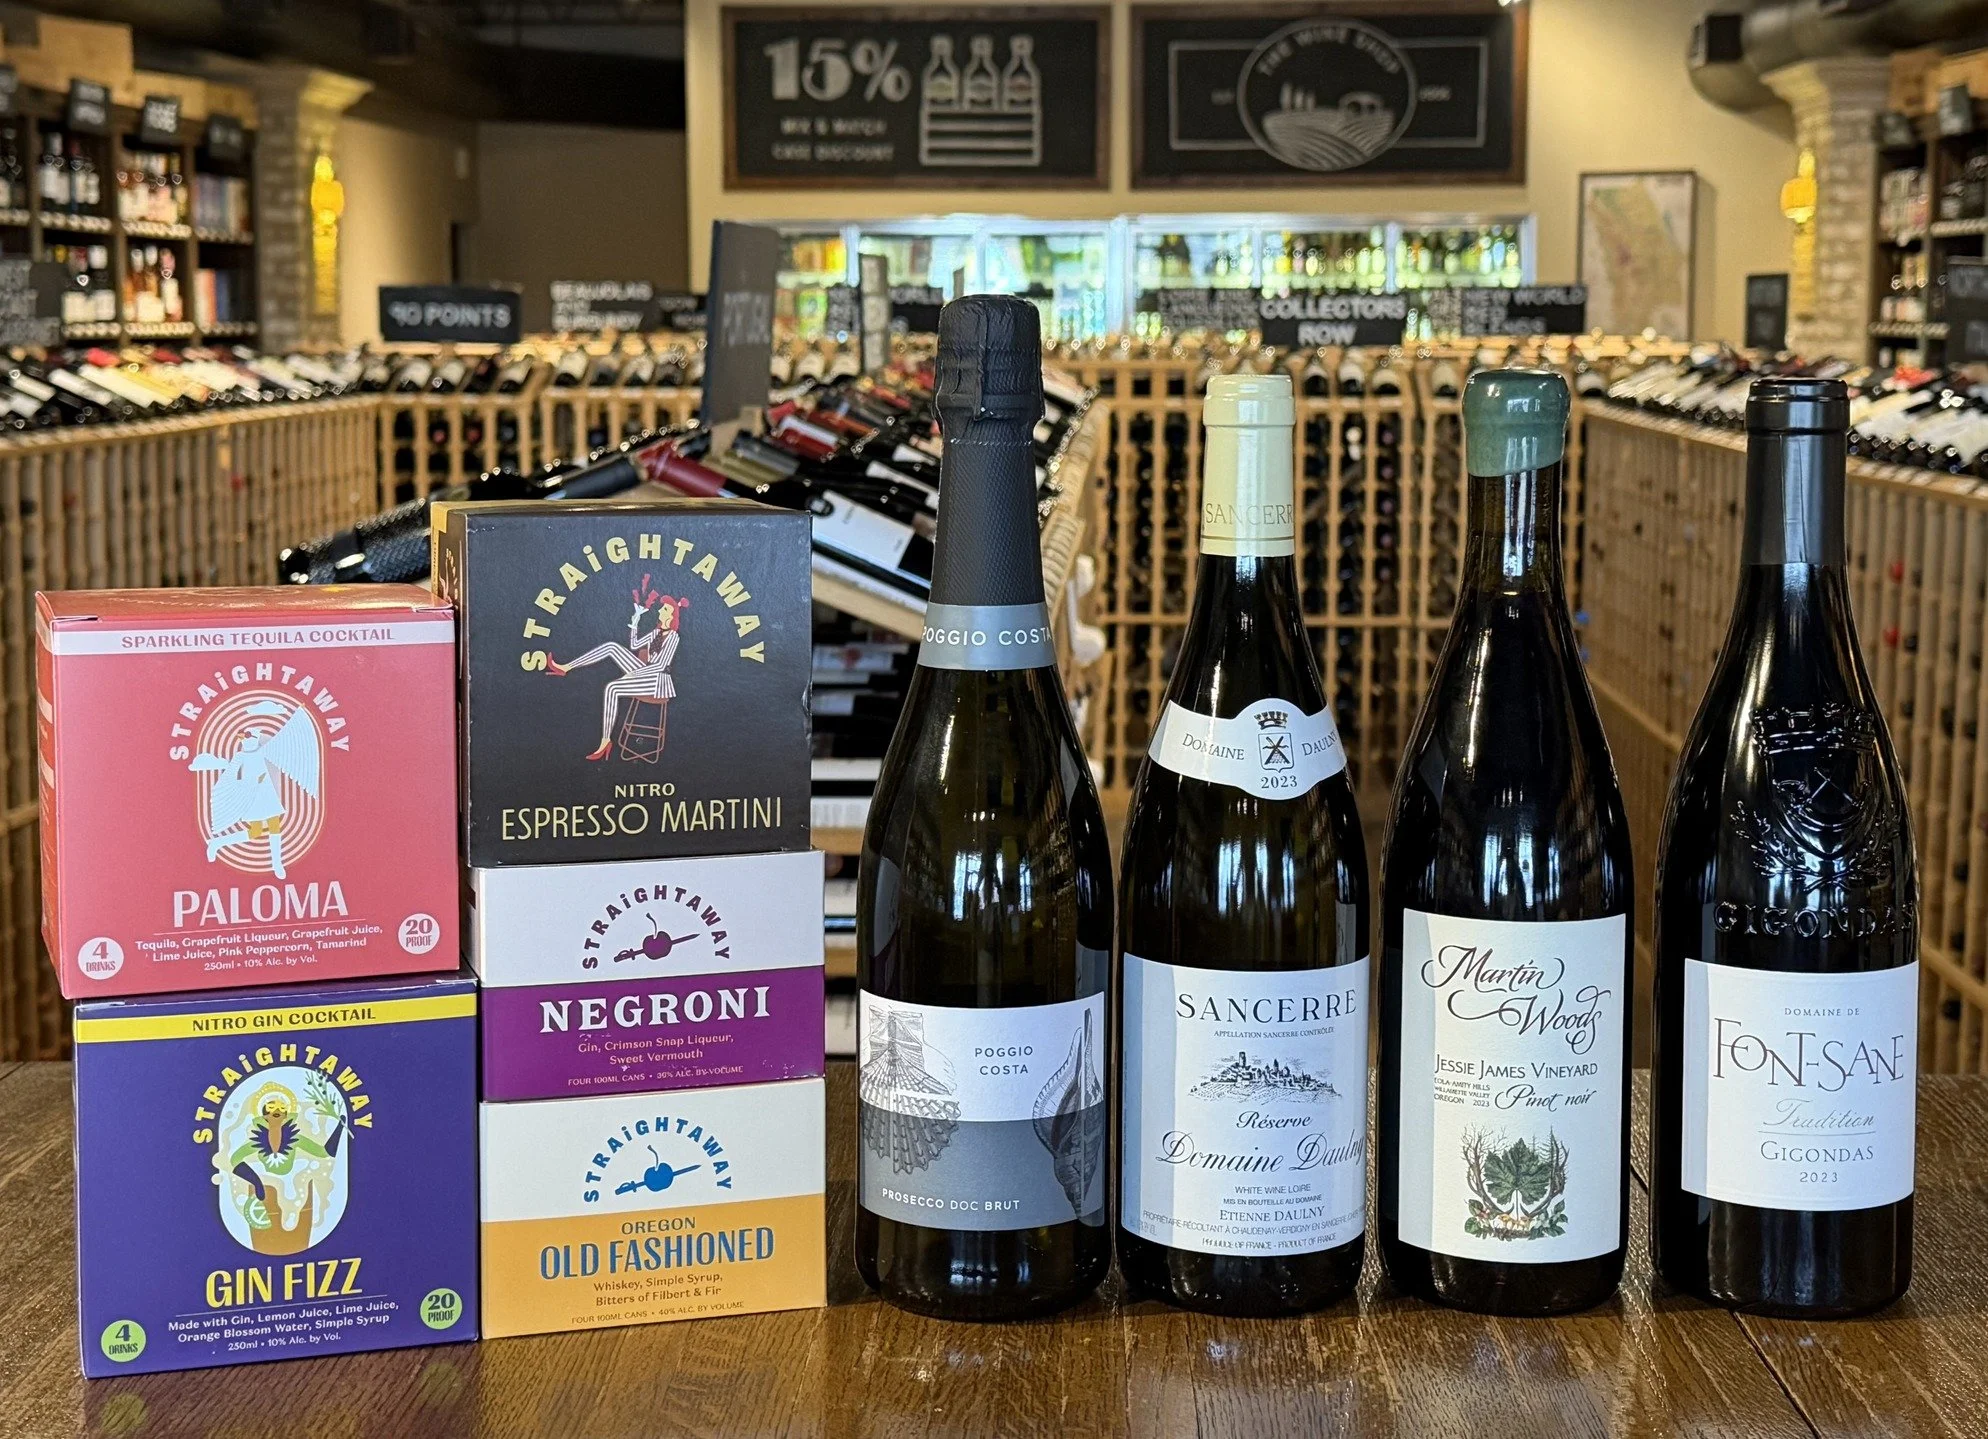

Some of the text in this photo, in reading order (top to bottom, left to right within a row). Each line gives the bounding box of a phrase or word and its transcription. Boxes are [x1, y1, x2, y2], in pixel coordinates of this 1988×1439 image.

[763, 38, 911, 101] 15%
[389, 301, 511, 328] 90 POINTS
[1260, 295, 1406, 320] COLLECTORS
[1298, 322, 1357, 346] ROW
[122, 626, 395, 649] SPARKLING TEQUILA COCKTAIL
[922, 626, 1052, 646] POGGIO COSTA
[1182, 733, 1245, 761] DOMAINE
[614, 782, 675, 799] NITRO
[1261, 776, 1298, 789] 2023
[502, 796, 782, 841] ESPRESSO MARTINI
[173, 880, 348, 928] PALOMA
[405, 918, 433, 935] 20
[135, 924, 383, 951] Tequila, Grapefruit Liqueur, Grapefruit Juice,
[405, 935, 433, 947] PROOF
[92, 941, 108, 958] 4
[153, 937, 367, 962] Lime Juice, Pink Peppercorn, Tamarind
[85, 959, 116, 973] DRINKS
[204, 954, 318, 971] 250ml 10% Alc. by Vol.
[1421, 945, 1565, 993] Martin
[539, 985, 770, 1034] NEGRONI
[1176, 989, 1357, 1023] SANCERRE
[1784, 1006, 1860, 1017] DOMAINE DE
[192, 1007, 376, 1032] NITRO GIN COCKTAIL
[1447, 985, 1611, 1055] Woods
[578, 1033, 734, 1053] Gin, Crimson Snap Liqueur,
[1214, 1029, 1298, 1039] APPELLATION SANCERRE
[609, 1049, 703, 1065] Sweet Vermouth
[975, 1045, 1034, 1058] POGGIO
[568, 1078, 592, 1086] FOUR
[594, 1075, 620, 1084] 100ML
[622, 1073, 645, 1082] CANS
[980, 1064, 1029, 1076] COSTA
[1433, 1093, 1490, 1107] OREGON 2023
[1494, 1083, 1597, 1112] Pinot noir
[1236, 1110, 1313, 1129] Réserve
[1763, 1097, 1875, 1130] Tradition
[1155, 1128, 1364, 1173] Domaine Daulny
[1760, 1140, 1874, 1163] GIGONDAS
[1800, 1171, 1838, 1183] 2023
[1235, 1184, 1311, 1194] WHITE WINE LOIRE
[882, 1188, 1020, 1211] PROSECCO DOC BRUT
[1248, 1198, 1284, 1206] BOUTEILLE
[1295, 1194, 1322, 1204] DOMAINE
[1220, 1206, 1325, 1221] ETIENNE DAULNY
[621, 1216, 696, 1236] OREGON
[540, 1225, 775, 1281] OLD FASHIONED
[1245, 1241, 1272, 1249] FRANCE
[205, 1257, 363, 1309] GIN FIZZ
[594, 1273, 723, 1292] Whiskey, Simple Syrup,
[427, 1293, 456, 1310] 20
[596, 1285, 722, 1307] Bitters of Filbert & Fir
[168, 1301, 400, 1332] Made with Gin, Lemon Juice, Lime Juice,
[427, 1309, 456, 1322] PROOF
[572, 1301, 745, 1324] FOUR 100ML CANS 40% BY VOLUME
[115, 1324, 131, 1341] 4
[178, 1313, 390, 1344] Orange Blossom Water, Simple Syrup
[108, 1342, 138, 1355] DRINKS
[228, 1331, 342, 1351] 250ml 10% Alc. by Vol.
